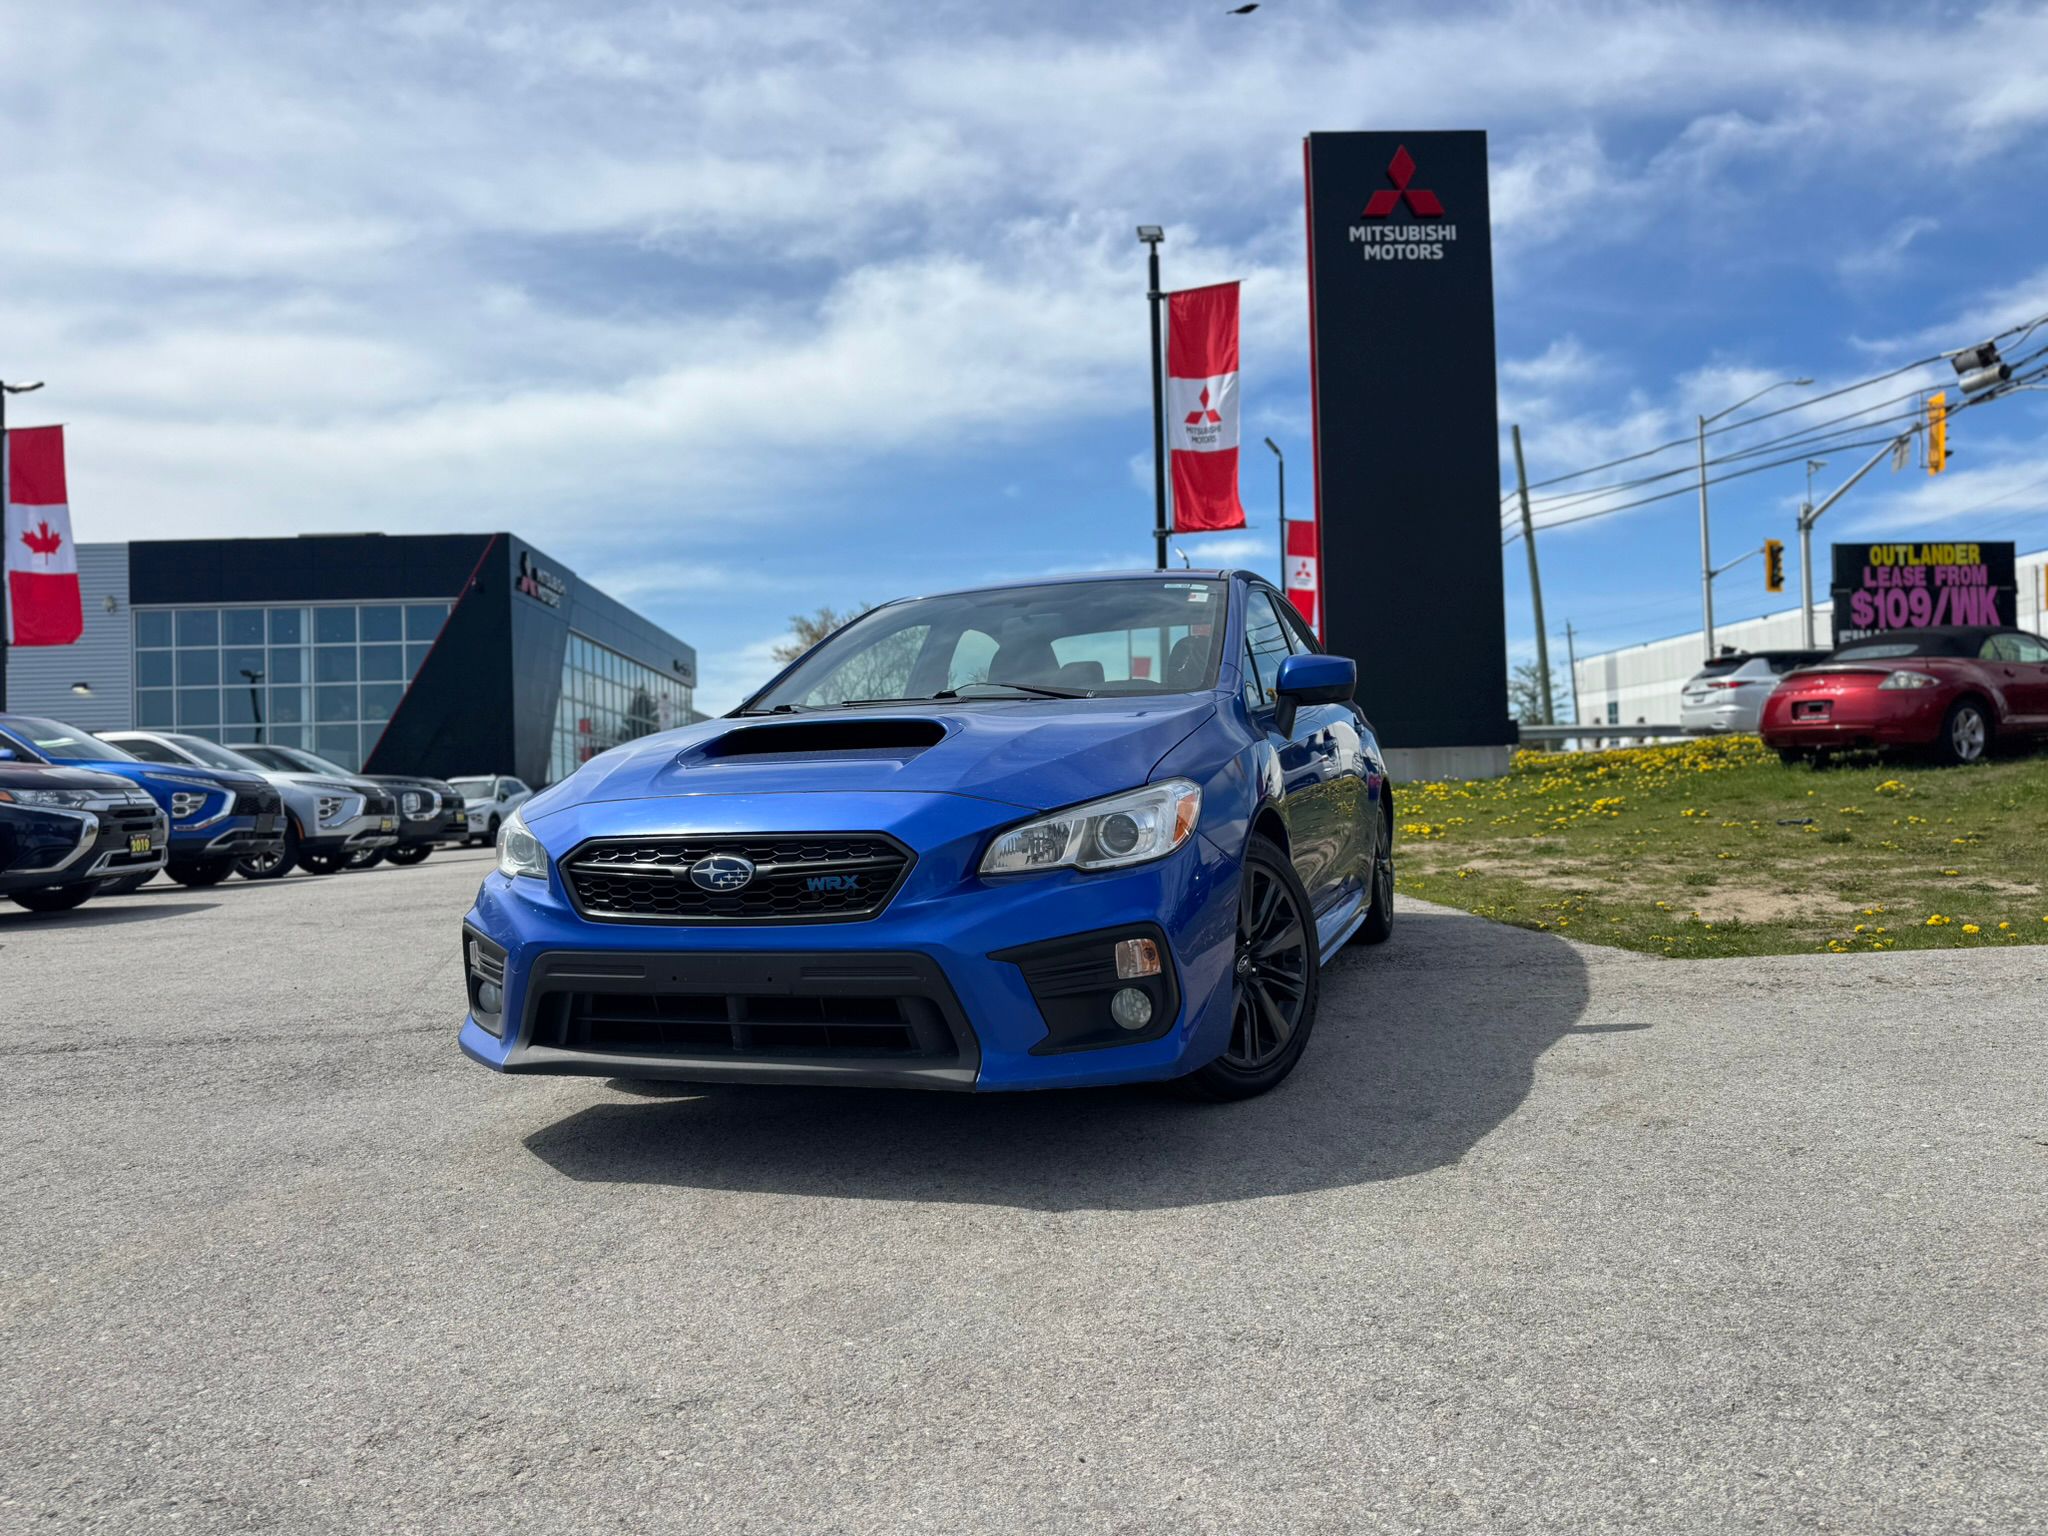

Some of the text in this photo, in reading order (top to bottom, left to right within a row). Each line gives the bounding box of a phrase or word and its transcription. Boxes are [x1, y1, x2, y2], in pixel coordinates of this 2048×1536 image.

[1348, 225, 1457, 242] MITSUBISHI
[1364, 243, 1444, 261] MOTORS
[1869, 543, 1982, 567] OUTLANDER
[1863, 563, 1988, 588] LEASE FROM
[1851, 585, 2001, 630] $109/WK
[130, 838, 150, 852] 2019
[806, 874, 860, 892] WRX
